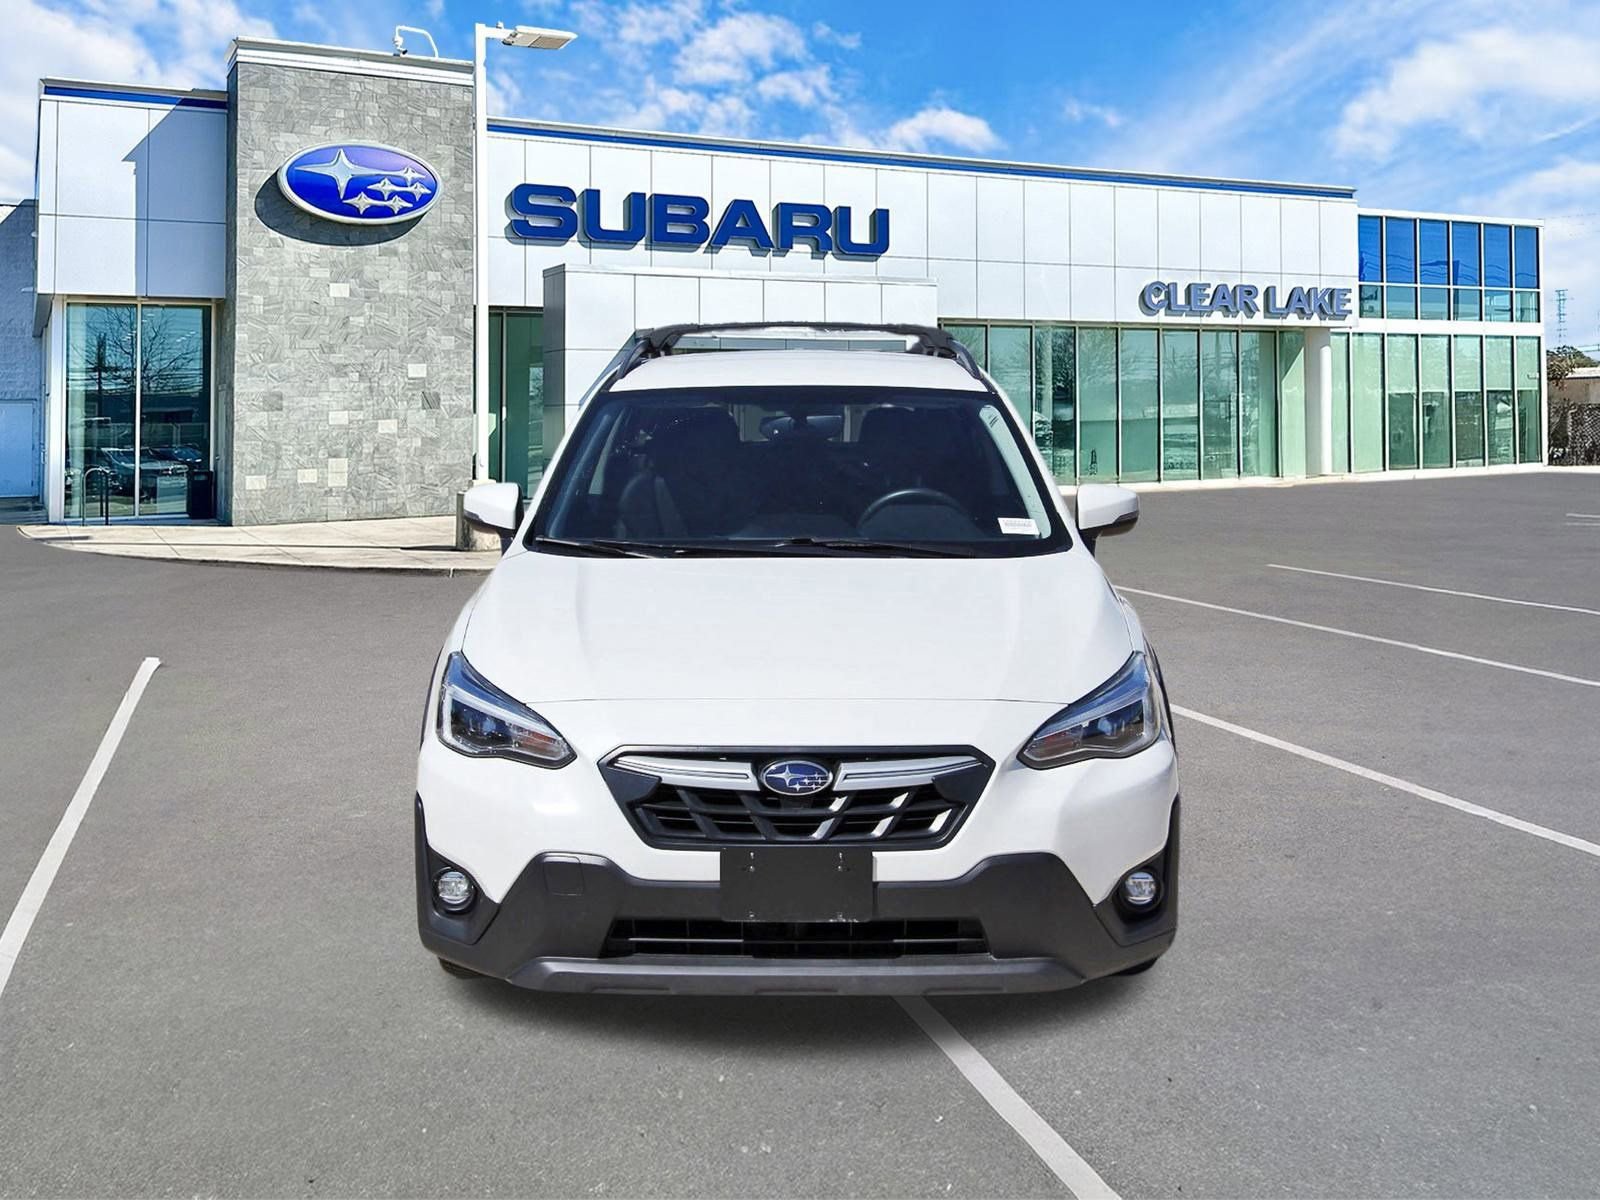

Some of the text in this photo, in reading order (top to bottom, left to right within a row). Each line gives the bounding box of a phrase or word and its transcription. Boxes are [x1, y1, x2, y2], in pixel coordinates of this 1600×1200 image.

[507, 183, 890, 259] SUBARU
[1140, 281, 1353, 319] CLEAR LAKE
